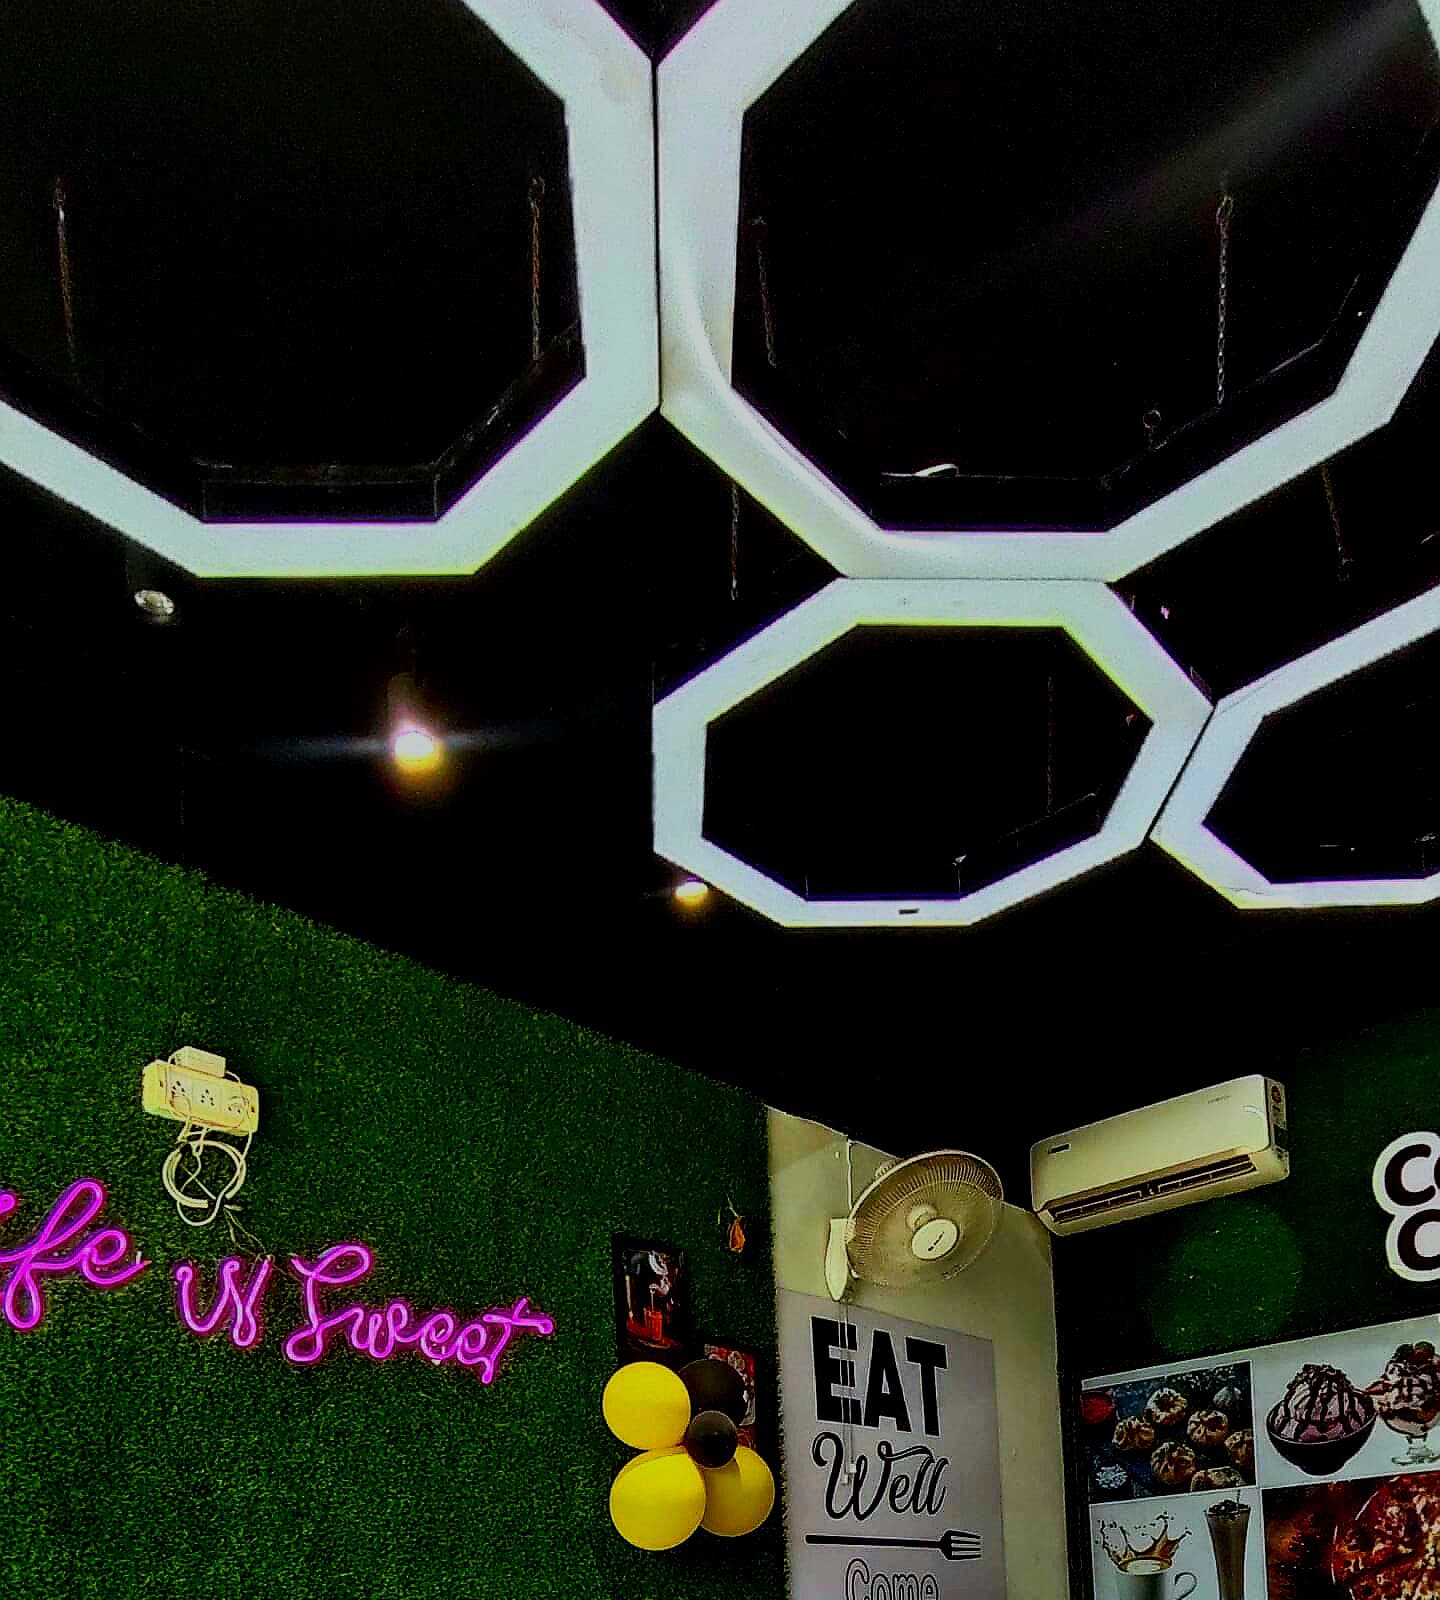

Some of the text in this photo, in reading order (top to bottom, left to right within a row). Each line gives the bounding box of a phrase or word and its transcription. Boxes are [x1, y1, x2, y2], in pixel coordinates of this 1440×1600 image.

[284, 1243, 555, 1385] Sweet
[810, 1315, 949, 1437] EAT
[811, 1431, 949, 1521] Well
